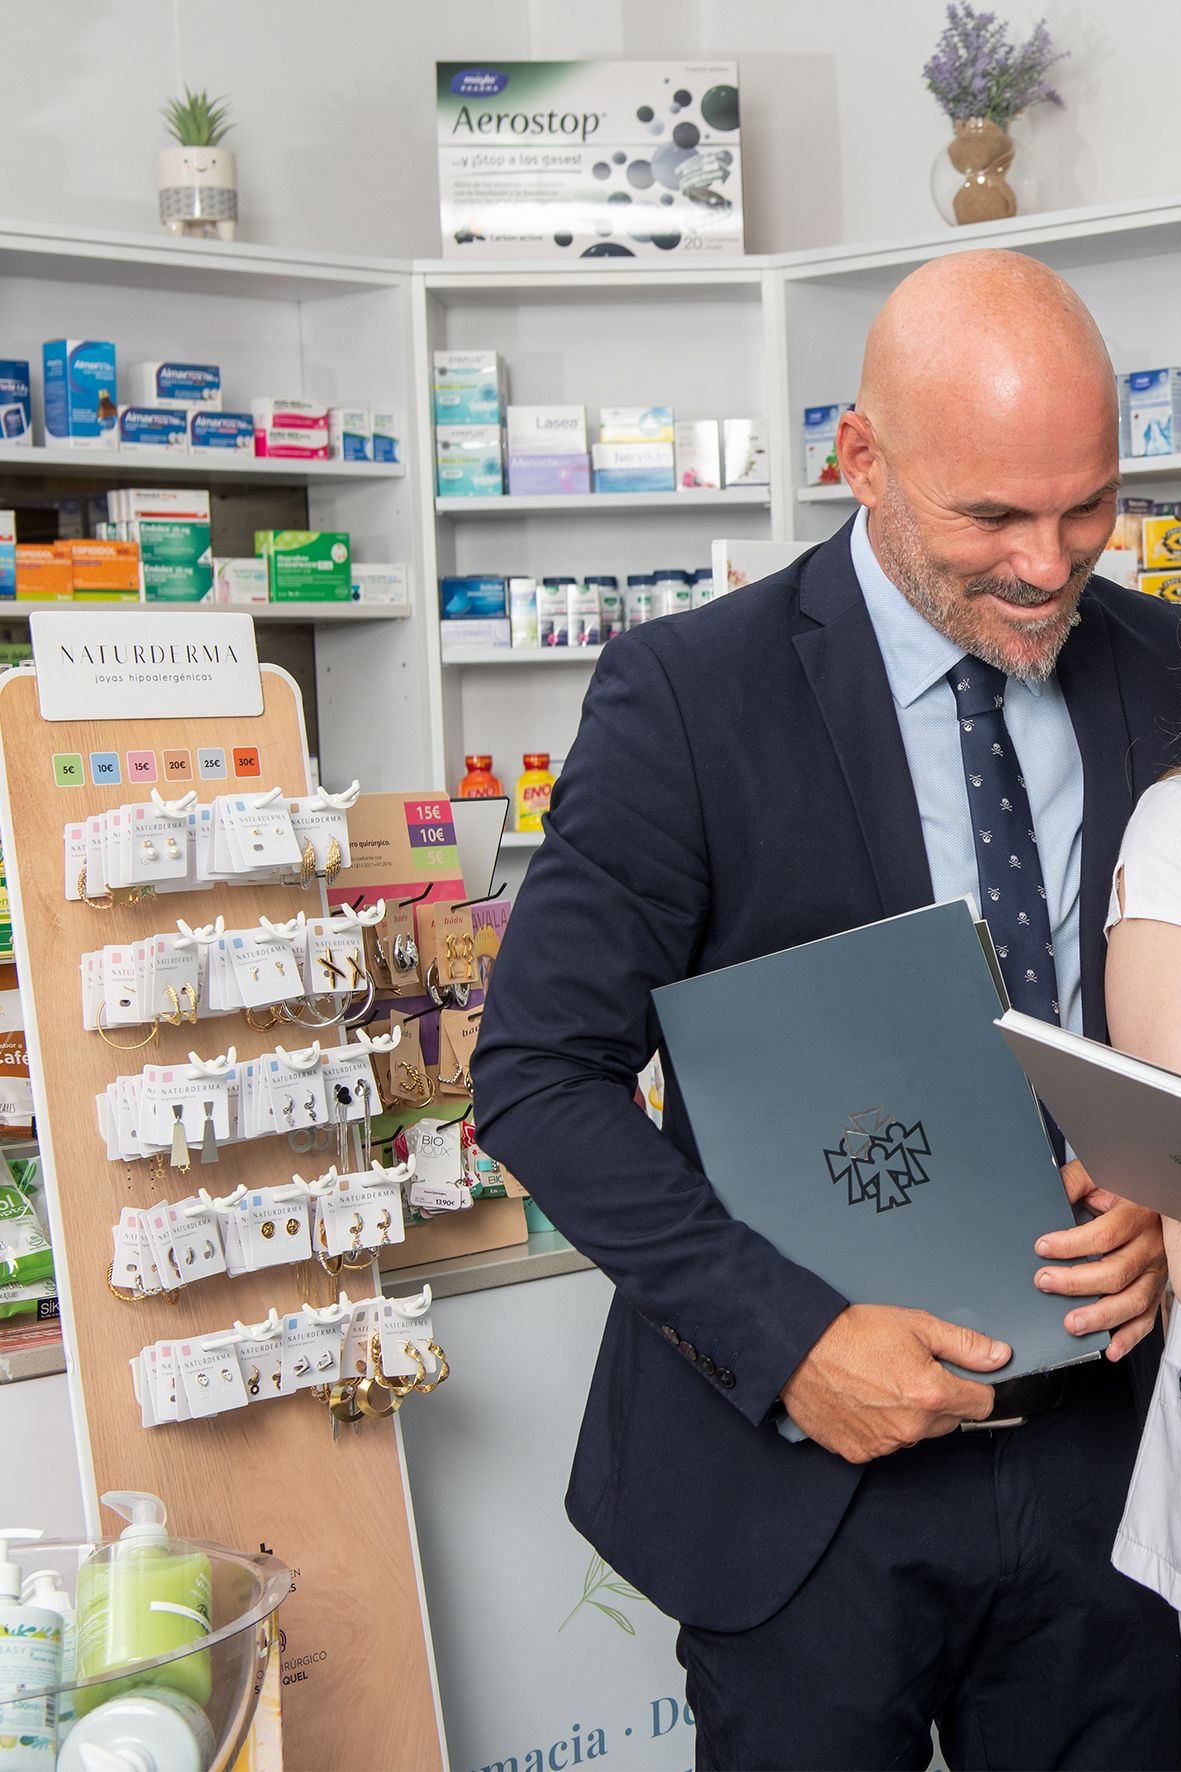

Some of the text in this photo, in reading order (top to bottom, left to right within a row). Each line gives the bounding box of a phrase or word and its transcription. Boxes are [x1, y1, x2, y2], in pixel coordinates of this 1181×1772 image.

[452, 106, 600, 142] Aerostop
[59, 644, 239, 665] NATURDERMA
[95, 672, 213, 684] joyas hipoalergénicas
[98, 764, 113, 772] 10€
[134, 762, 149, 771] 15€
[169, 761, 185, 769] 20€
[204, 759, 220, 768] 25€
[238, 758, 254, 766] 30€
[63, 766, 75, 774] 5€
[524, 784, 551, 800] ENO
[416, 805, 441, 820] 15€
[136, 822, 182, 832] NATURDERMA
[420, 828, 445, 843] 10€
[428, 850, 444, 865] 5€
[236, 945, 286, 961] NATURDERMA
[272, 1069, 318, 1084] NATURDERMA
[161, 1083, 221, 1095] NATURDERMA
[422, 1135, 443, 1146] BIO
[339, 1189, 395, 1205] NATURDERMA
[253, 1205, 302, 1220] NATURDERMA
[287, 1327, 337, 1342] NATURDERMA
[240, 1341, 283, 1356] NATURDERM
[184, 1352, 231, 1369] NATURDERMA
